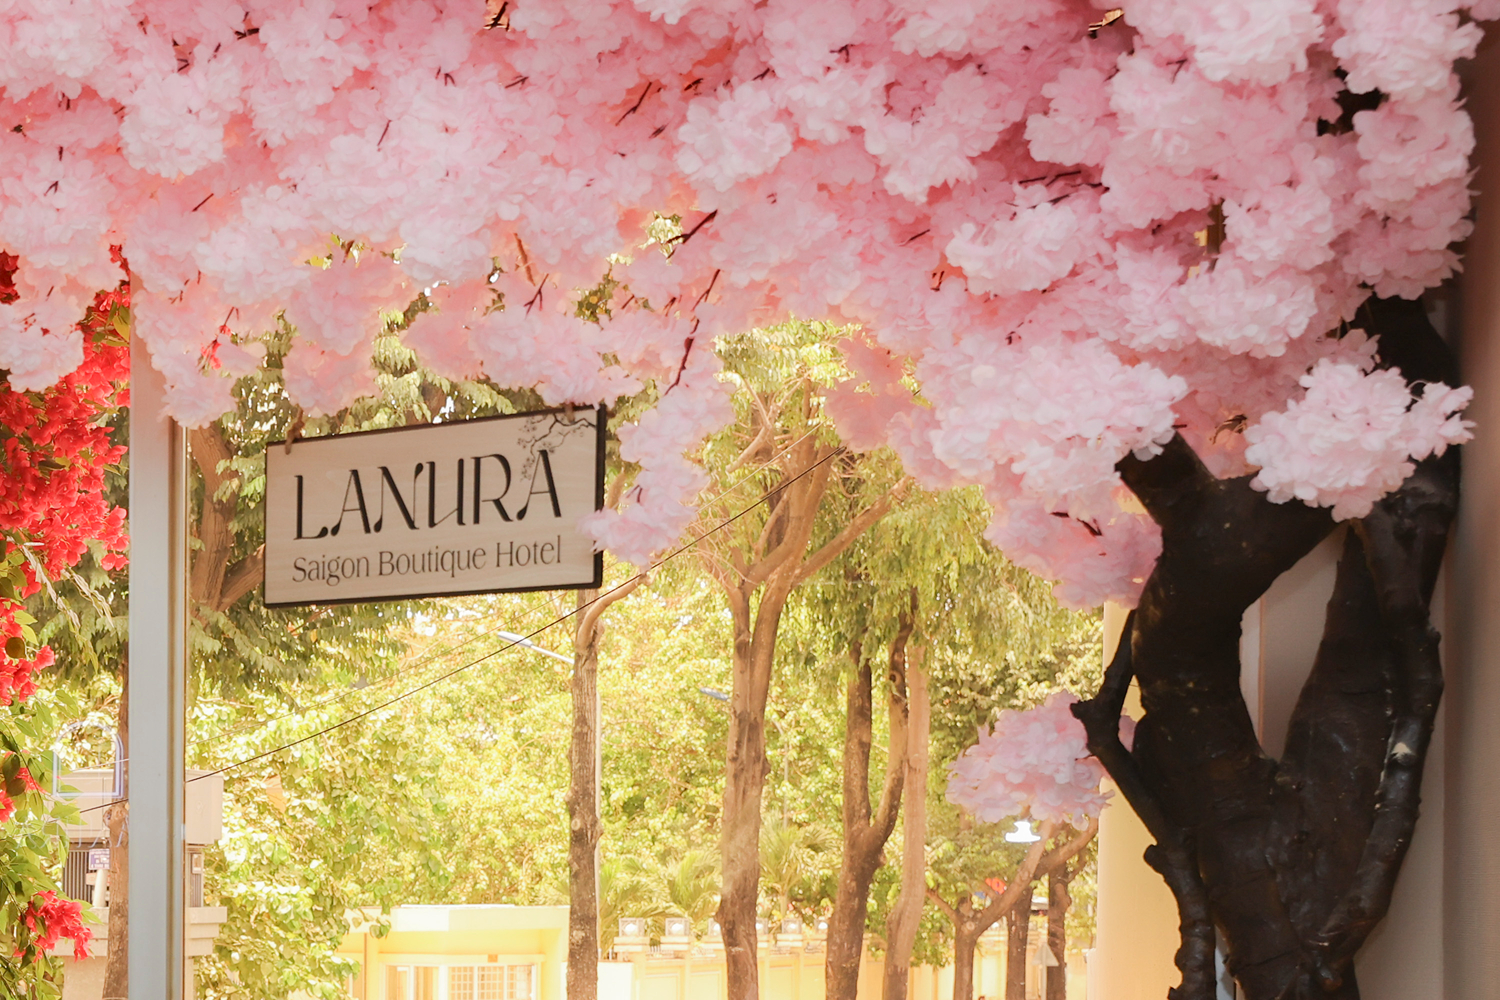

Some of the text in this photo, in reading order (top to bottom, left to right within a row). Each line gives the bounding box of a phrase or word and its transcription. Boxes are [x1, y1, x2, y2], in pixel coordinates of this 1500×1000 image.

[293, 449, 562, 540] LANURA
[292, 535, 562, 586] Saigon Boutique Hotel
